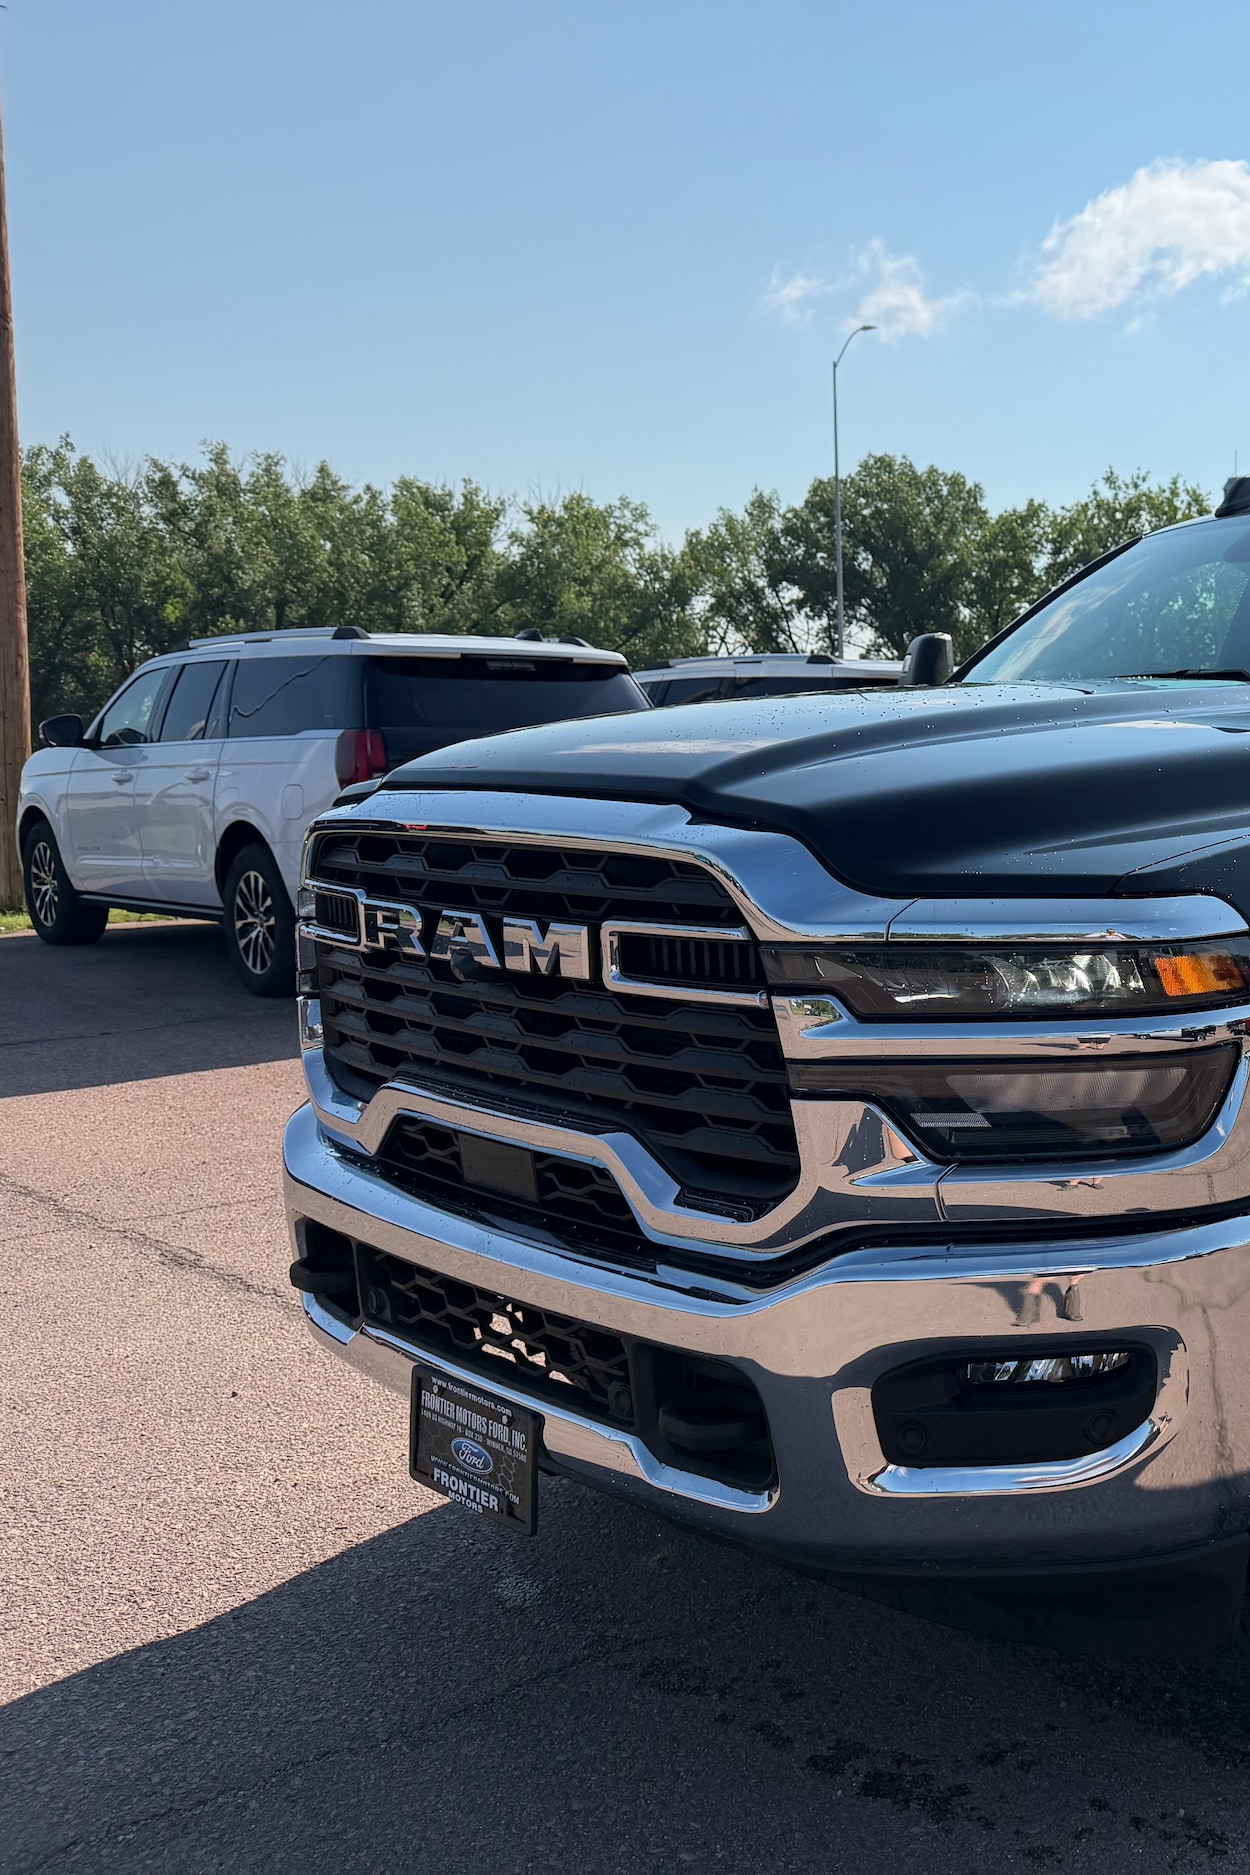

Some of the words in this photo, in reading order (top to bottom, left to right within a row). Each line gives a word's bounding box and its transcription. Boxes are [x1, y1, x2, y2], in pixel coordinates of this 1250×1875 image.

[364, 899, 591, 980] RAM
[430, 1375, 513, 1418] www.frontiermotors.com
[421, 1389, 456, 1420] FRONTIER
[456, 1405, 488, 1434] MOTORS
[488, 1419, 511, 1446] FORD,
[511, 1429, 528, 1453] INC.
[458, 1442, 485, 1470] Ford
[433, 1466, 499, 1512] FRONTIER
[448, 1490, 484, 1514] MOTORS
